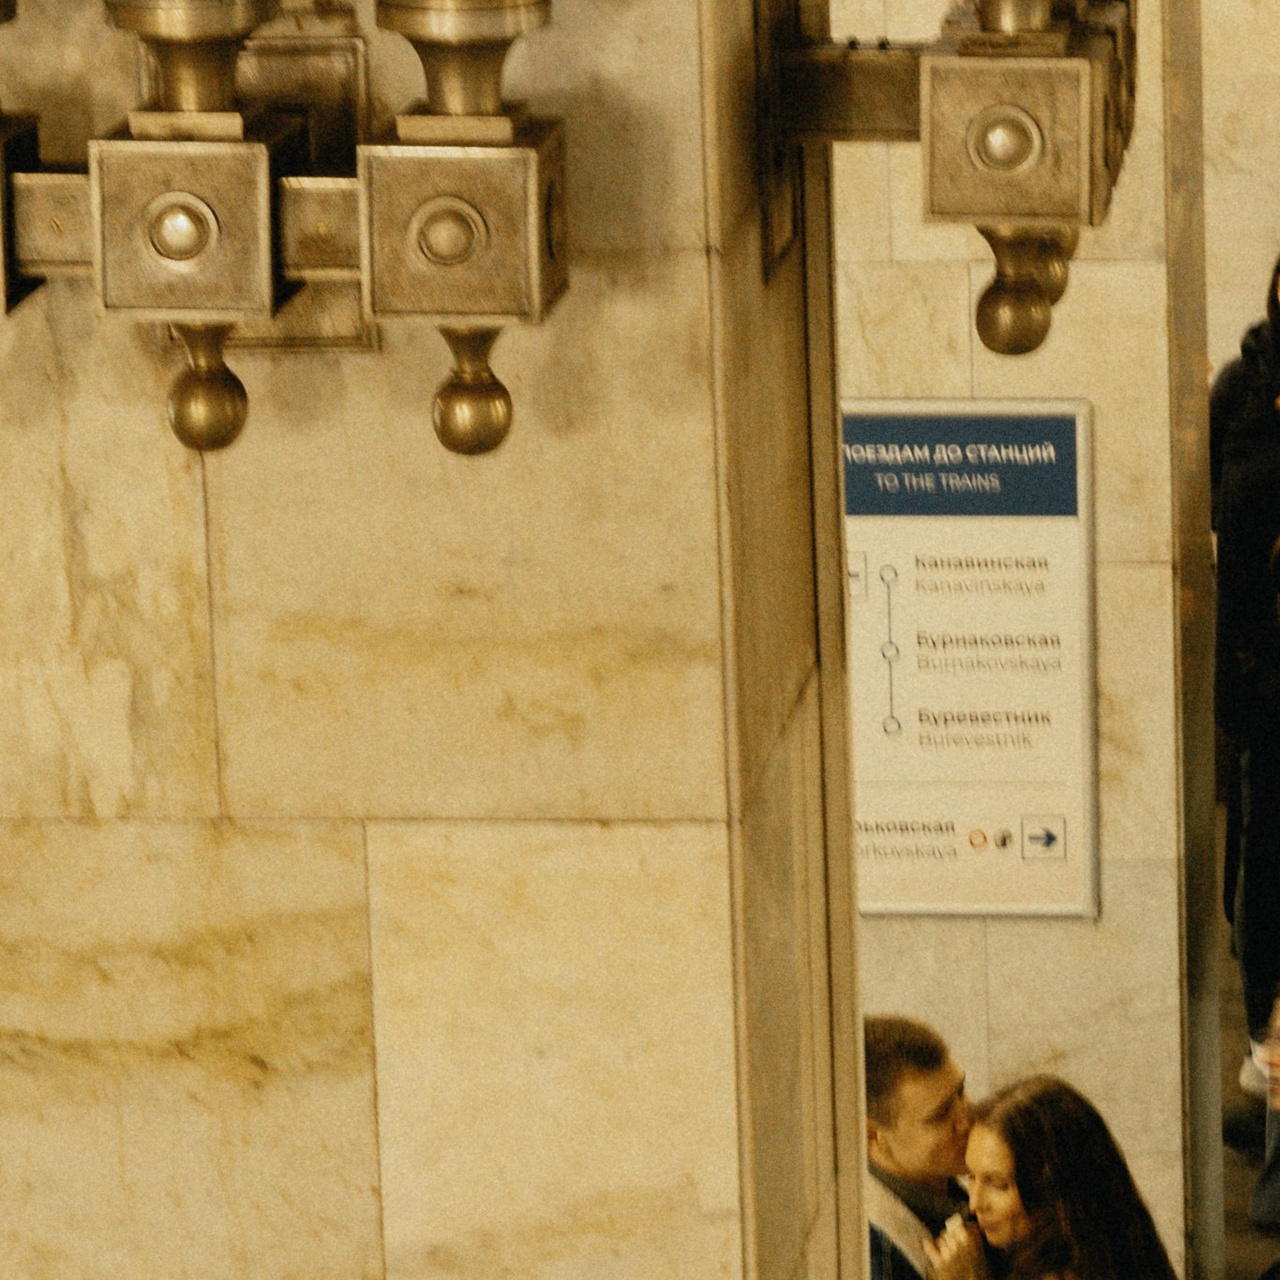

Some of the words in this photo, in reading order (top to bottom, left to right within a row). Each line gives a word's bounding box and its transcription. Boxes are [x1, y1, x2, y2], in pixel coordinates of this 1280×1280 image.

[933, 443, 963, 465] ДО
[965, 441, 1056, 466] СТАНЦИЙ
[876, 473, 900, 493] TO
[902, 473, 935, 493] THE
[940, 473, 1000, 493] TRAINS
[914, 554, 1049, 572] Канавинская
[916, 630, 1061, 651] Бурнаковская
[917, 708, 1052, 728] Буревестник
